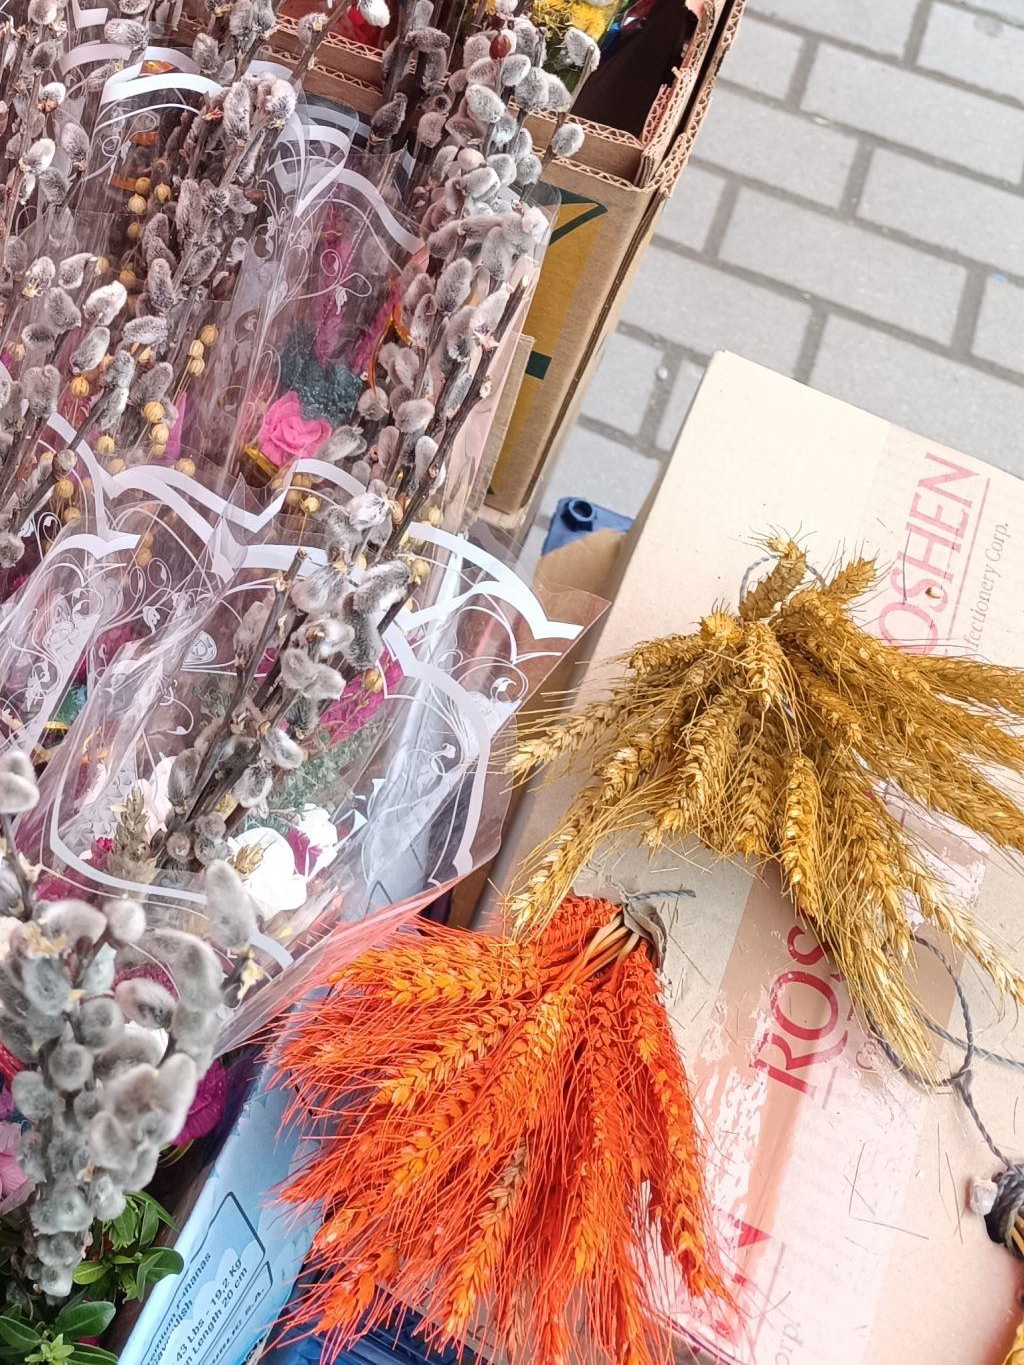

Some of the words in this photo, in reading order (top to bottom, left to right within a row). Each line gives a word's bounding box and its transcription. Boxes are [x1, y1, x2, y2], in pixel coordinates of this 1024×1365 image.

[878, 452, 981, 655] OSHEN
[192, 1309, 223, 1355] Length
[222, 1289, 234, 1308] 20
[234, 1267, 248, 1289] cm
